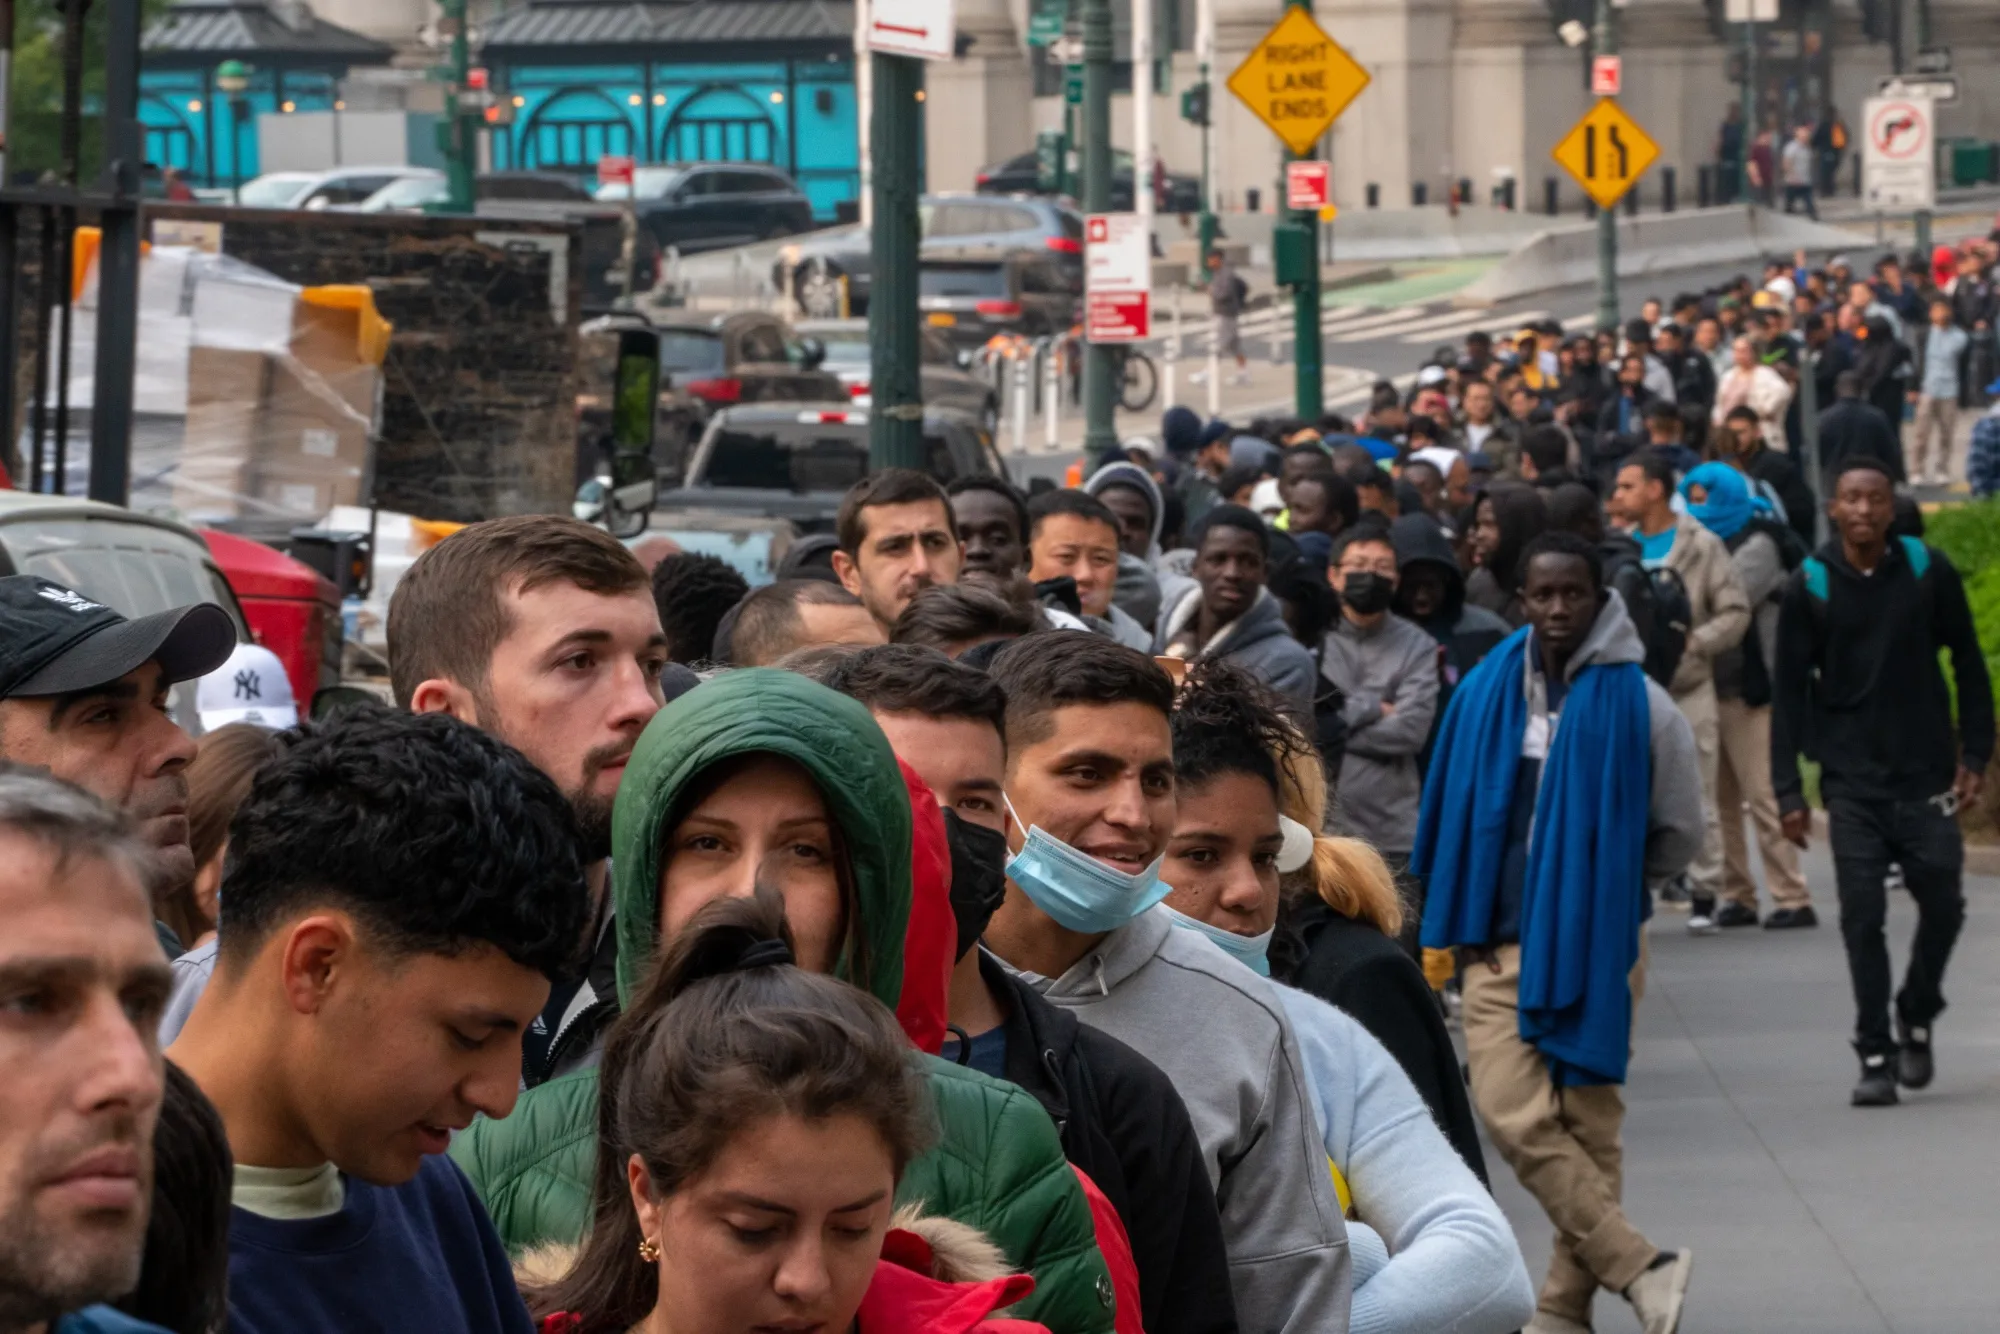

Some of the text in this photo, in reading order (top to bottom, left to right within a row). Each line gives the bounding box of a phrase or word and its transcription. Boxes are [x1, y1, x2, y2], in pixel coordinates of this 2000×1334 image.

[1265, 43, 1327, 64] RIGHT
[1266, 70, 1328, 93] LANE
[1269, 98, 1329, 120] ENDS
[234, 669, 261, 700] NY
